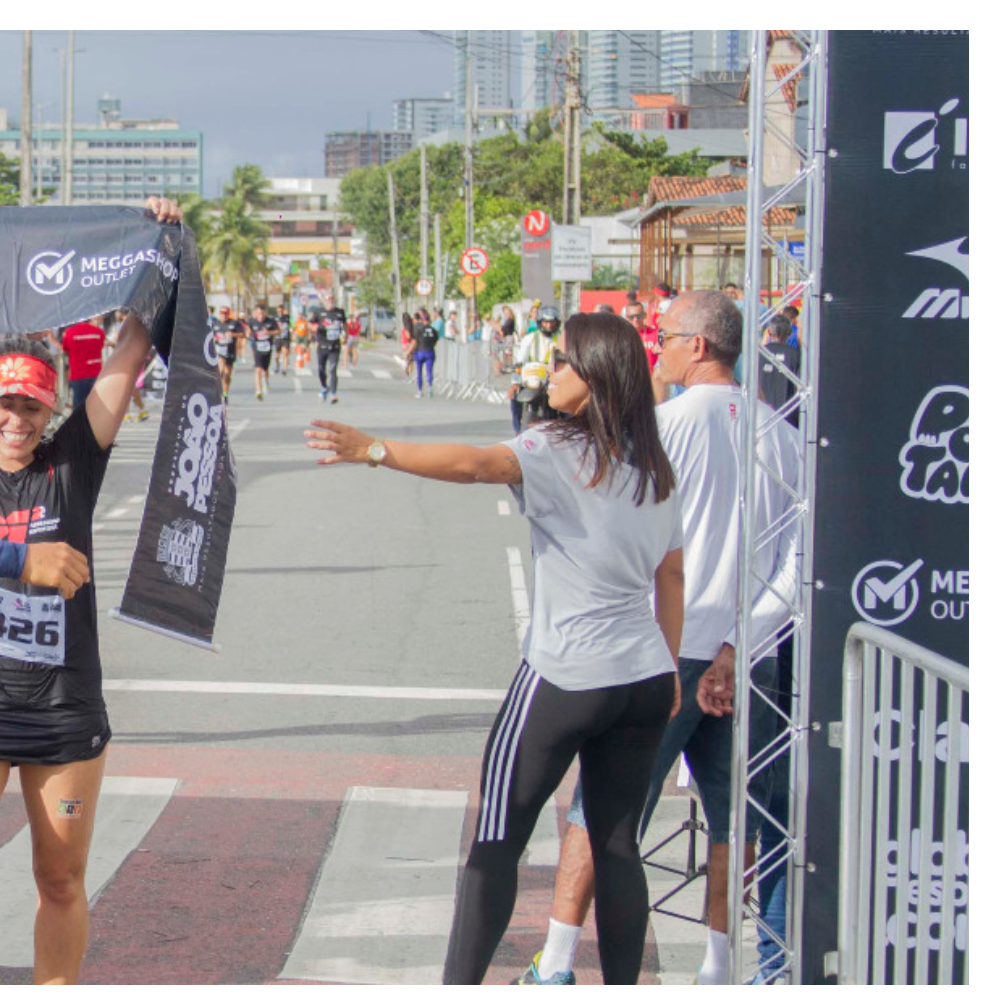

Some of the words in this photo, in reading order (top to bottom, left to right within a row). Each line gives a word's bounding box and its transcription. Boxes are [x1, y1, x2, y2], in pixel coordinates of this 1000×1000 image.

[81, 265, 136, 287] OUTLET
[174, 393, 209, 507] JOÃO
[193, 404, 223, 514] PESSOA
